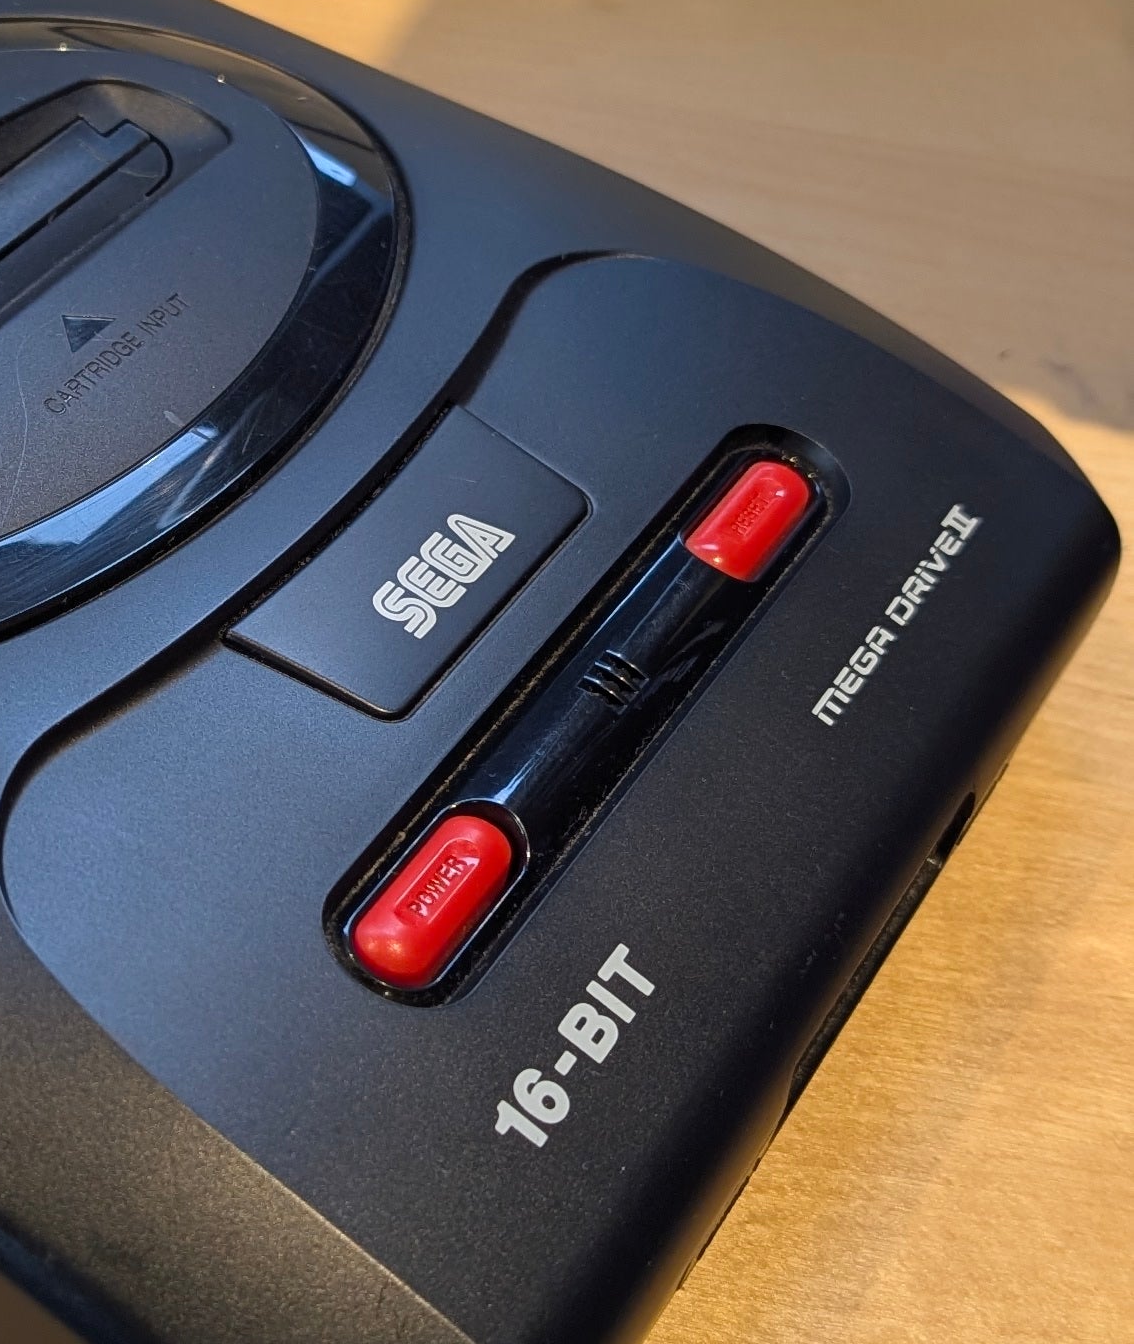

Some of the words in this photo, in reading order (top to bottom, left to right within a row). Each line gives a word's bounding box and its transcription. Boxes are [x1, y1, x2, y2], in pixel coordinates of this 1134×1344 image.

[44, 331, 144, 415] CARTRIDGE
[136, 293, 189, 338] INPUT
[372, 513, 516, 640] SEGA
[811, 626, 896, 726] MEGA
[408, 853, 468, 917] POWER
[494, 942, 655, 1148] 16-BIT
